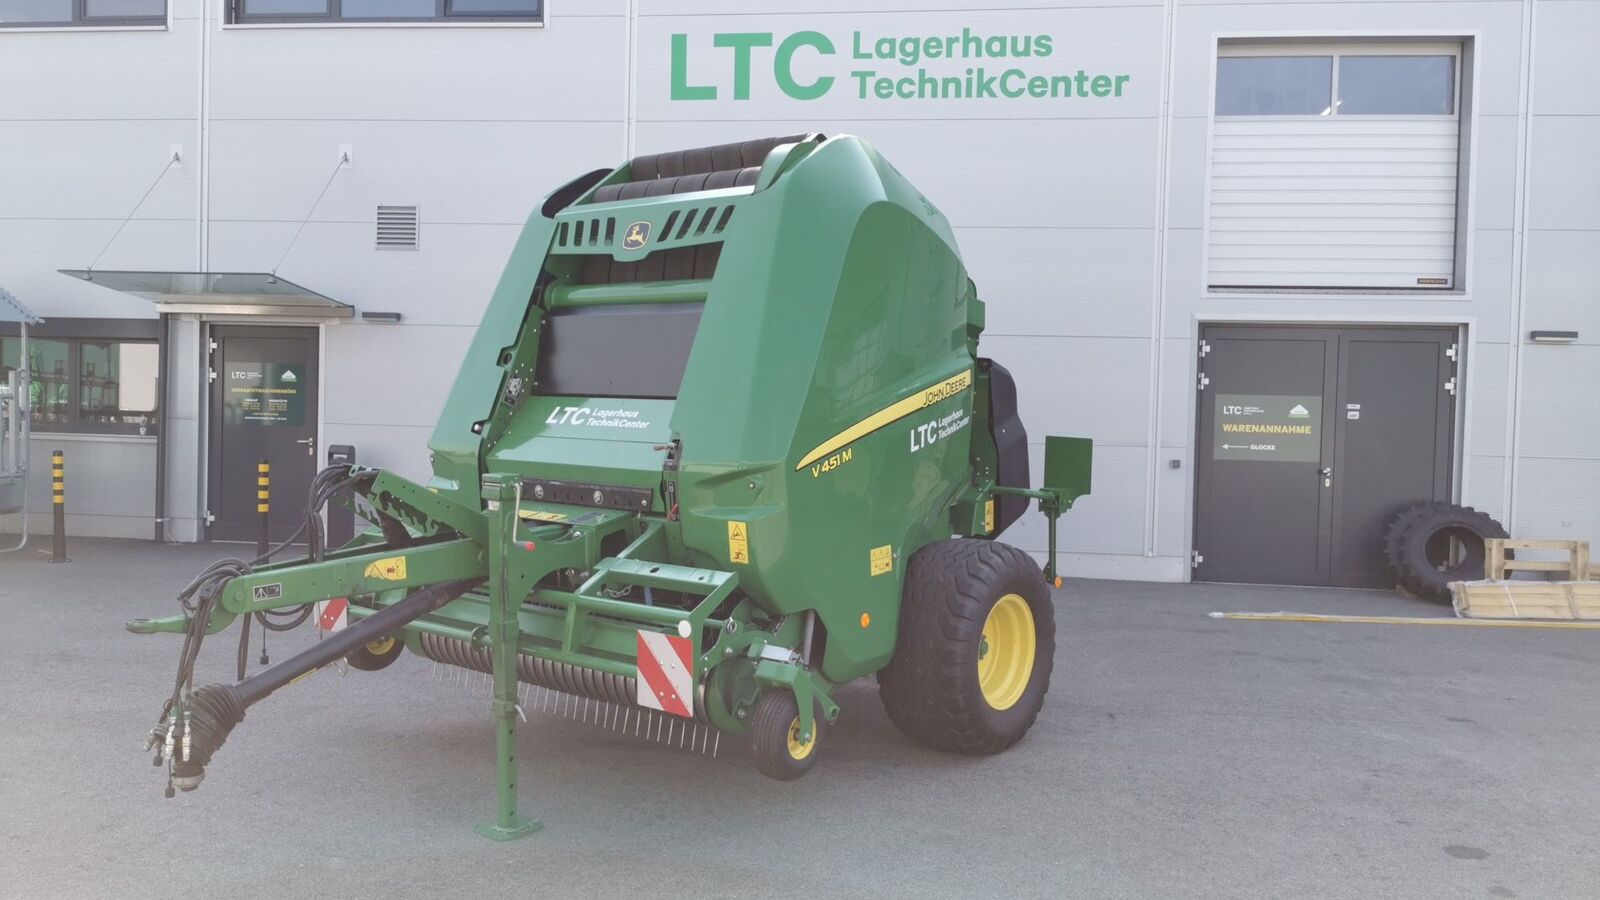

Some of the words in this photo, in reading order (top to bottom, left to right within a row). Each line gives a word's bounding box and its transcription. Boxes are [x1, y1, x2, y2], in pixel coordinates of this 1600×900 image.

[852, 27, 1053, 66] Lagerhaus
[670, 30, 836, 100] LTC
[851, 67, 1130, 99] TechnikCenter
[231, 371, 246, 379] LTC
[923, 388, 945, 406] JOHN
[945, 377, 967, 398] DEERE
[545, 406, 591, 425] LTC
[592, 408, 639, 418] Lagerhaus
[938, 408, 964, 428] Lagerhaus
[1223, 405, 1242, 415] LTC
[586, 417, 650, 429] TechnikCenter
[938, 416, 970, 440] TechnikCenter
[1223, 424, 1312, 434] WARENANNAHME
[910, 420, 937, 453] LTC
[811, 464, 820, 478] V
[821, 454, 841, 473] 451
[842, 448, 852, 463] M
